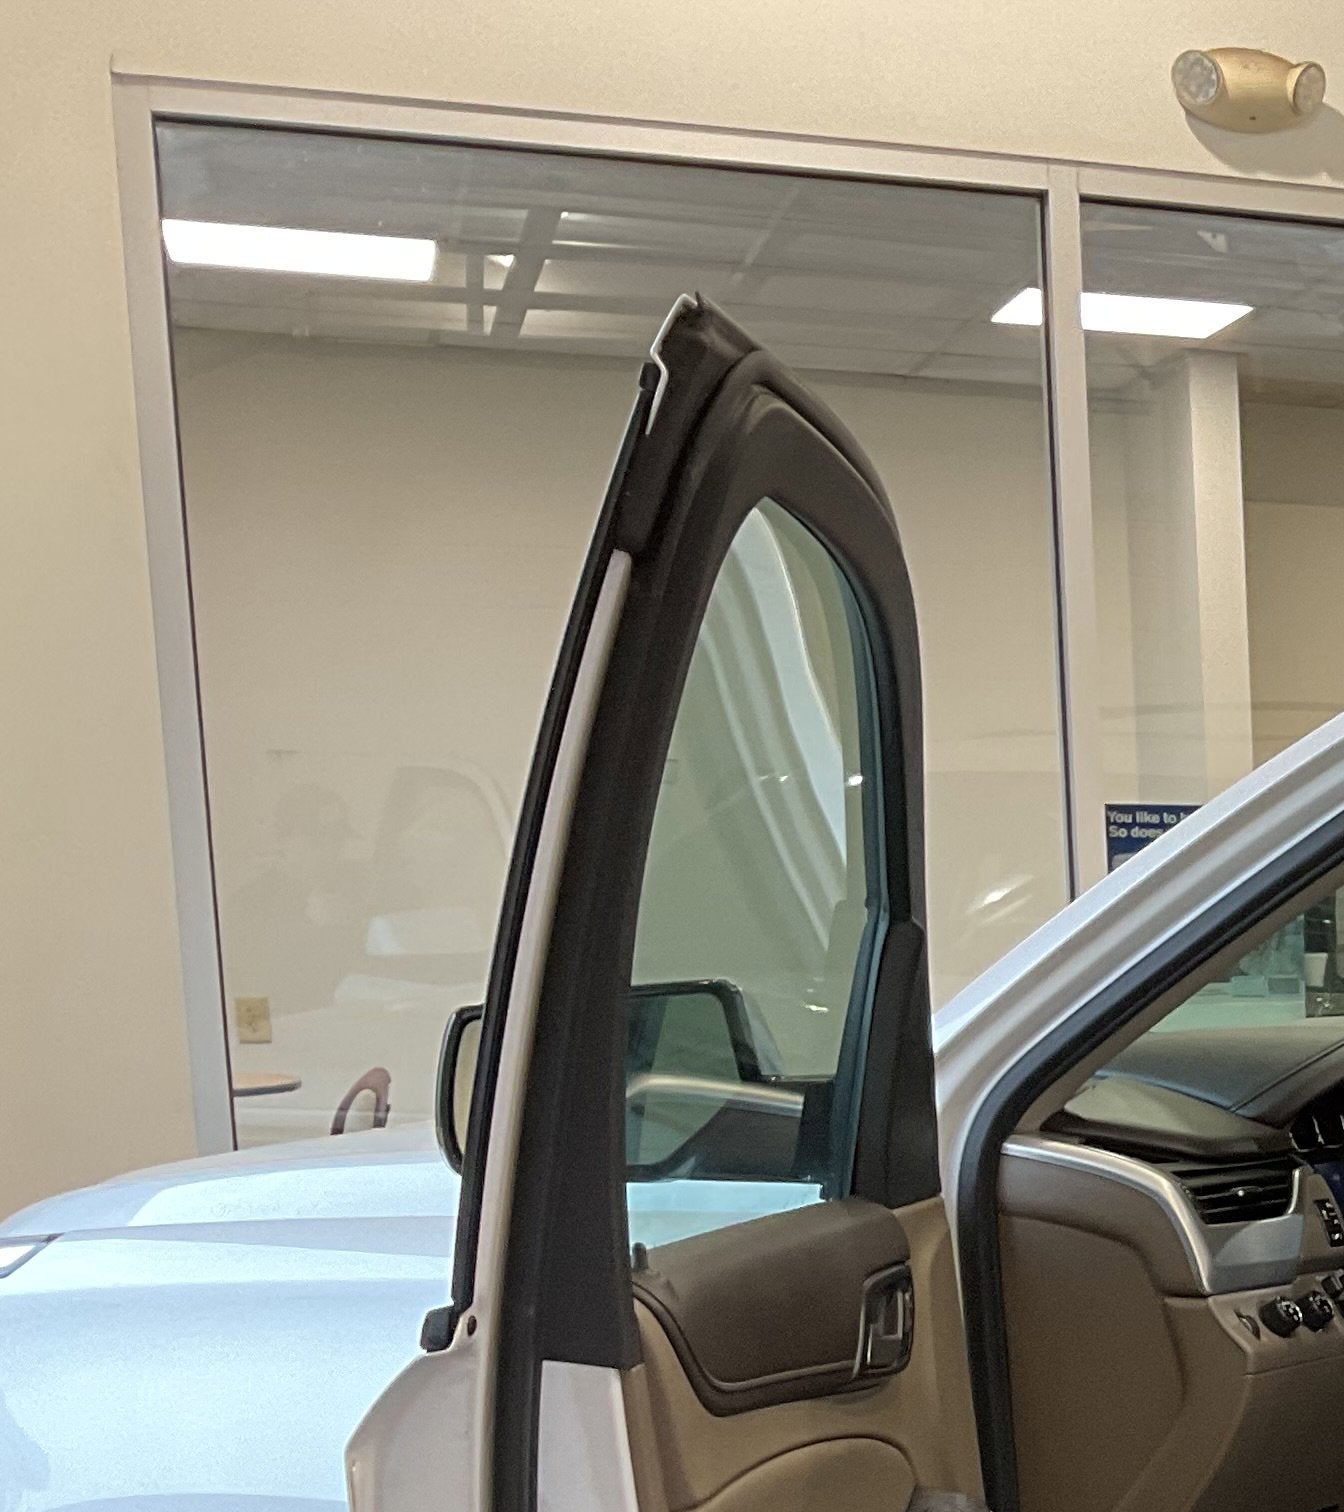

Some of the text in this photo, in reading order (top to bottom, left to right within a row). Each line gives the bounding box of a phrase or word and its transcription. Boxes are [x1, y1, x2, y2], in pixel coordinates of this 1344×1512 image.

[1136, 811, 1160, 823] like
[1163, 812, 1177, 823] to
[1108, 825, 1128, 838] So
